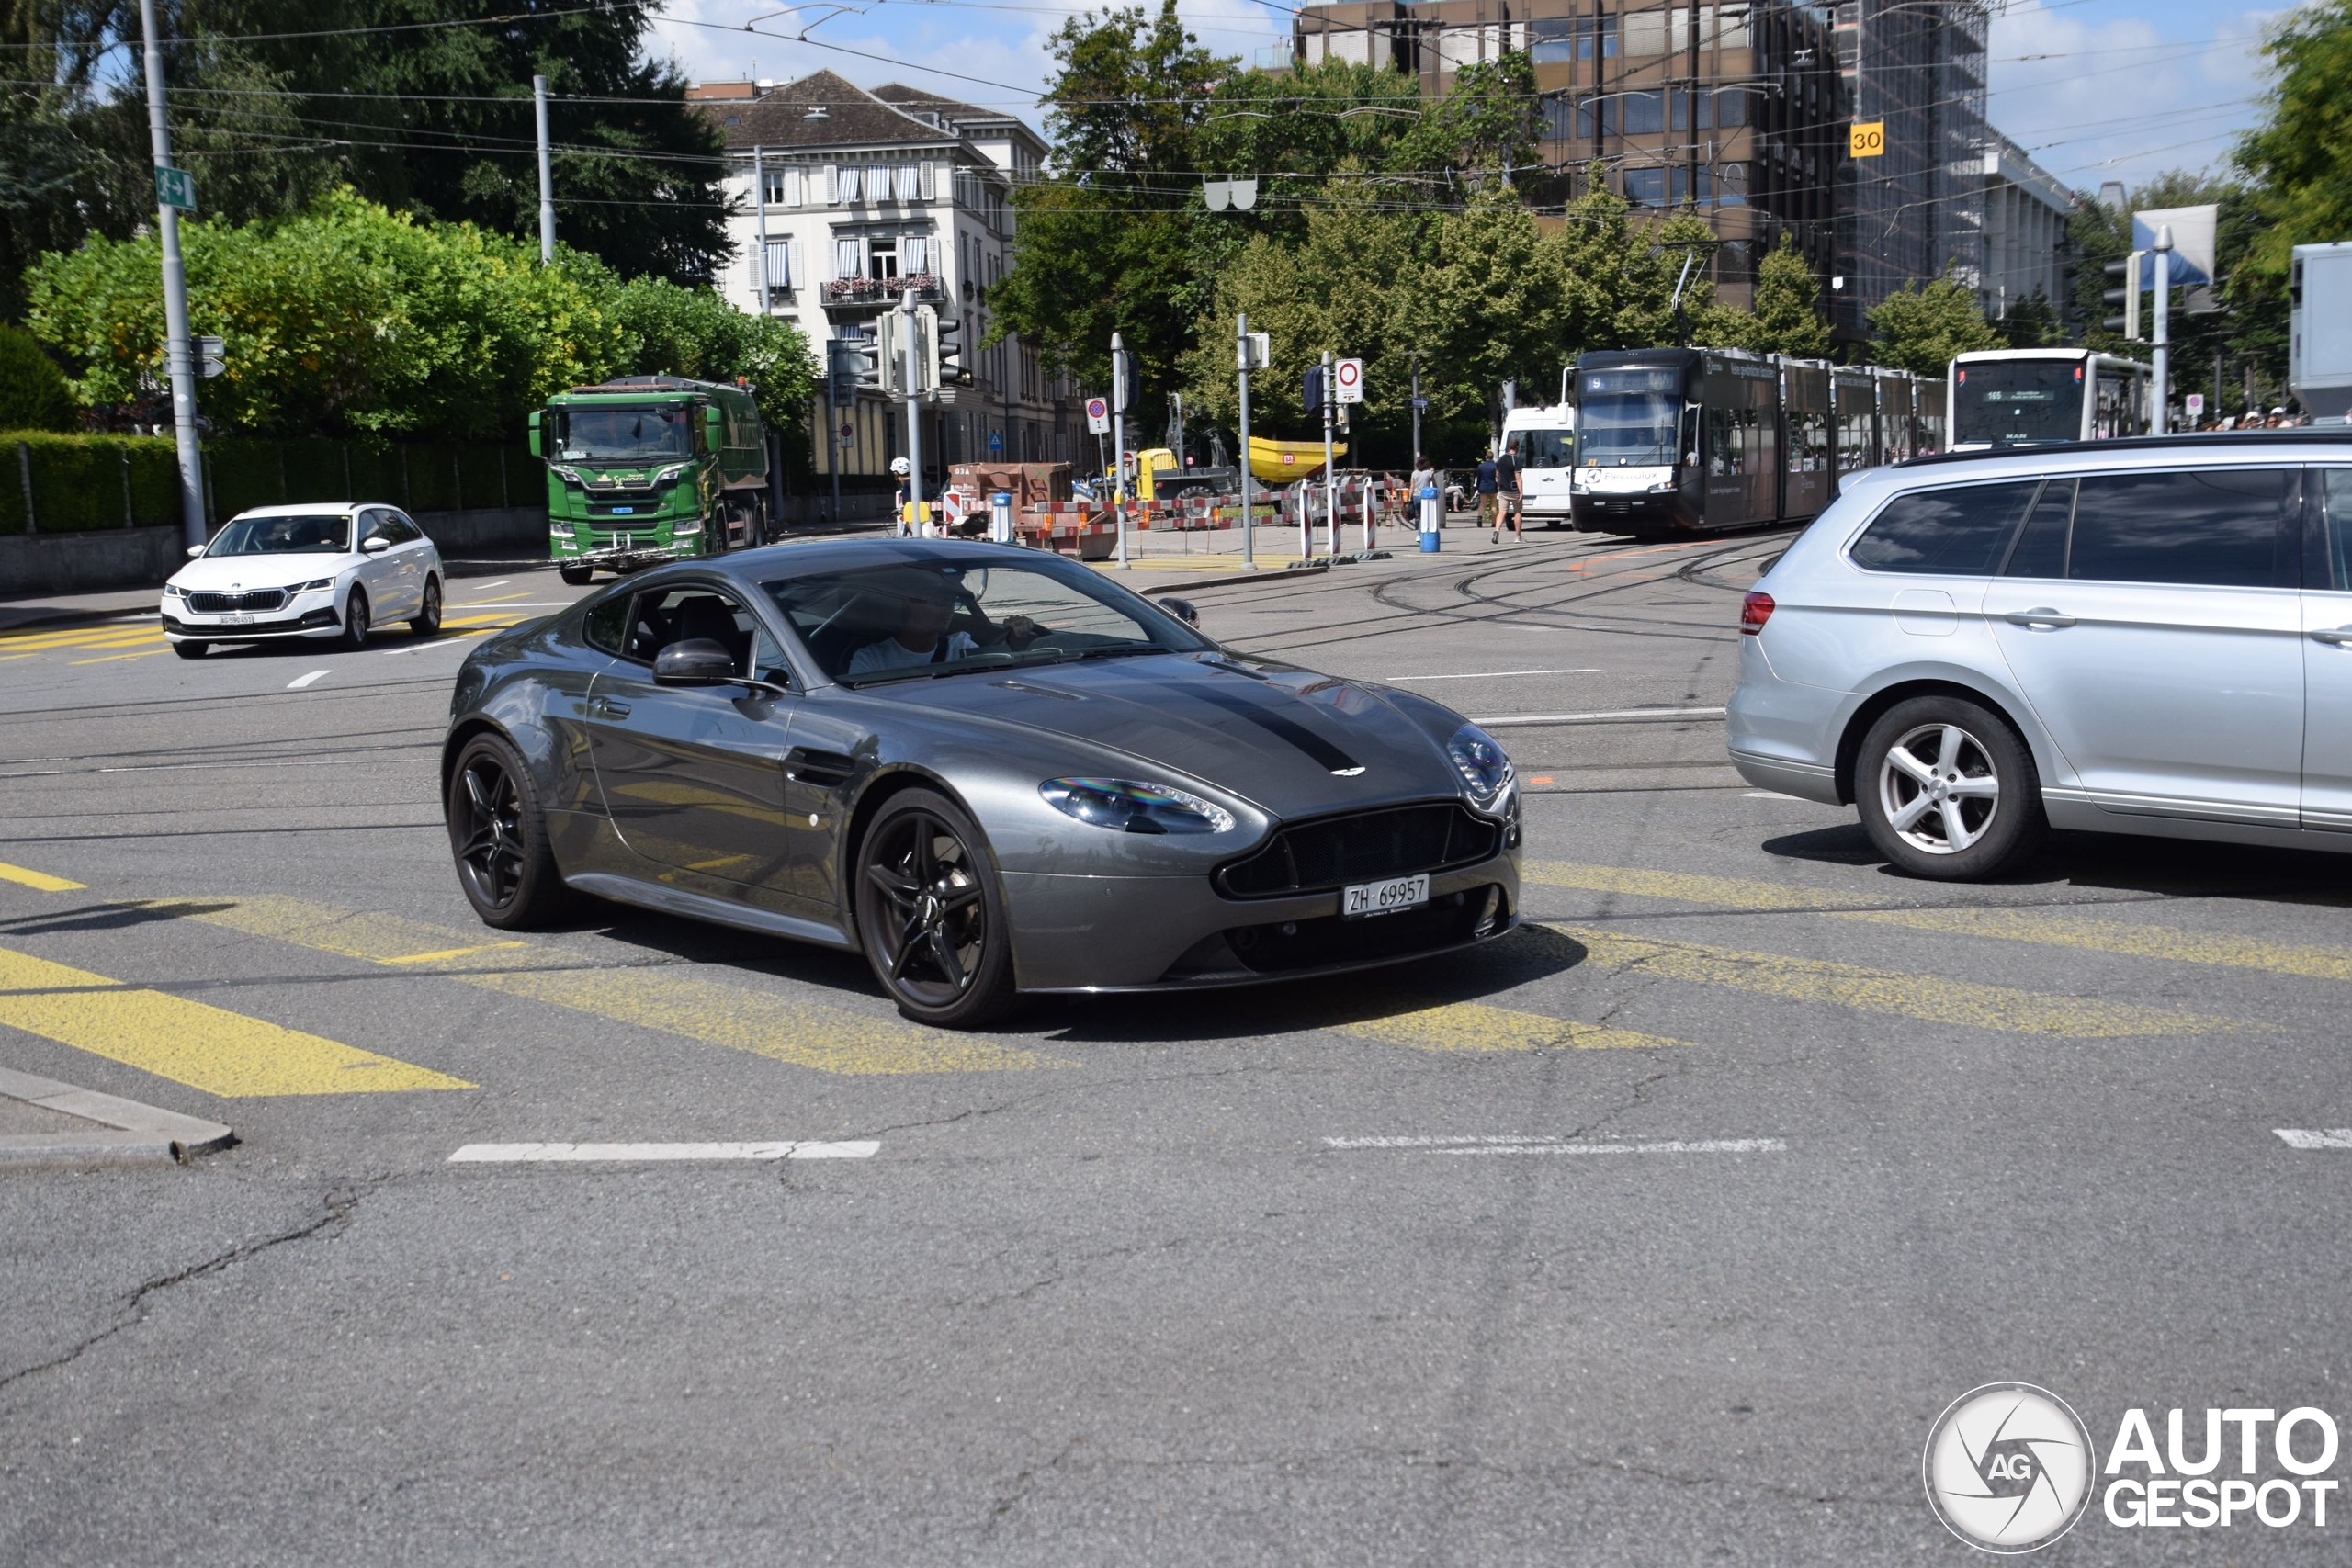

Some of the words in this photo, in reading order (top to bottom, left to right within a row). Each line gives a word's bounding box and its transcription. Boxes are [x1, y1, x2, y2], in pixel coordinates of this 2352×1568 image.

[1853, 131, 1881, 150] 30
[1592, 377, 1600, 388] 9
[1987, 391, 2002, 400] 165
[1604, 471, 1657, 480] Electrolux
[1379, 879, 1425, 906] 69957
